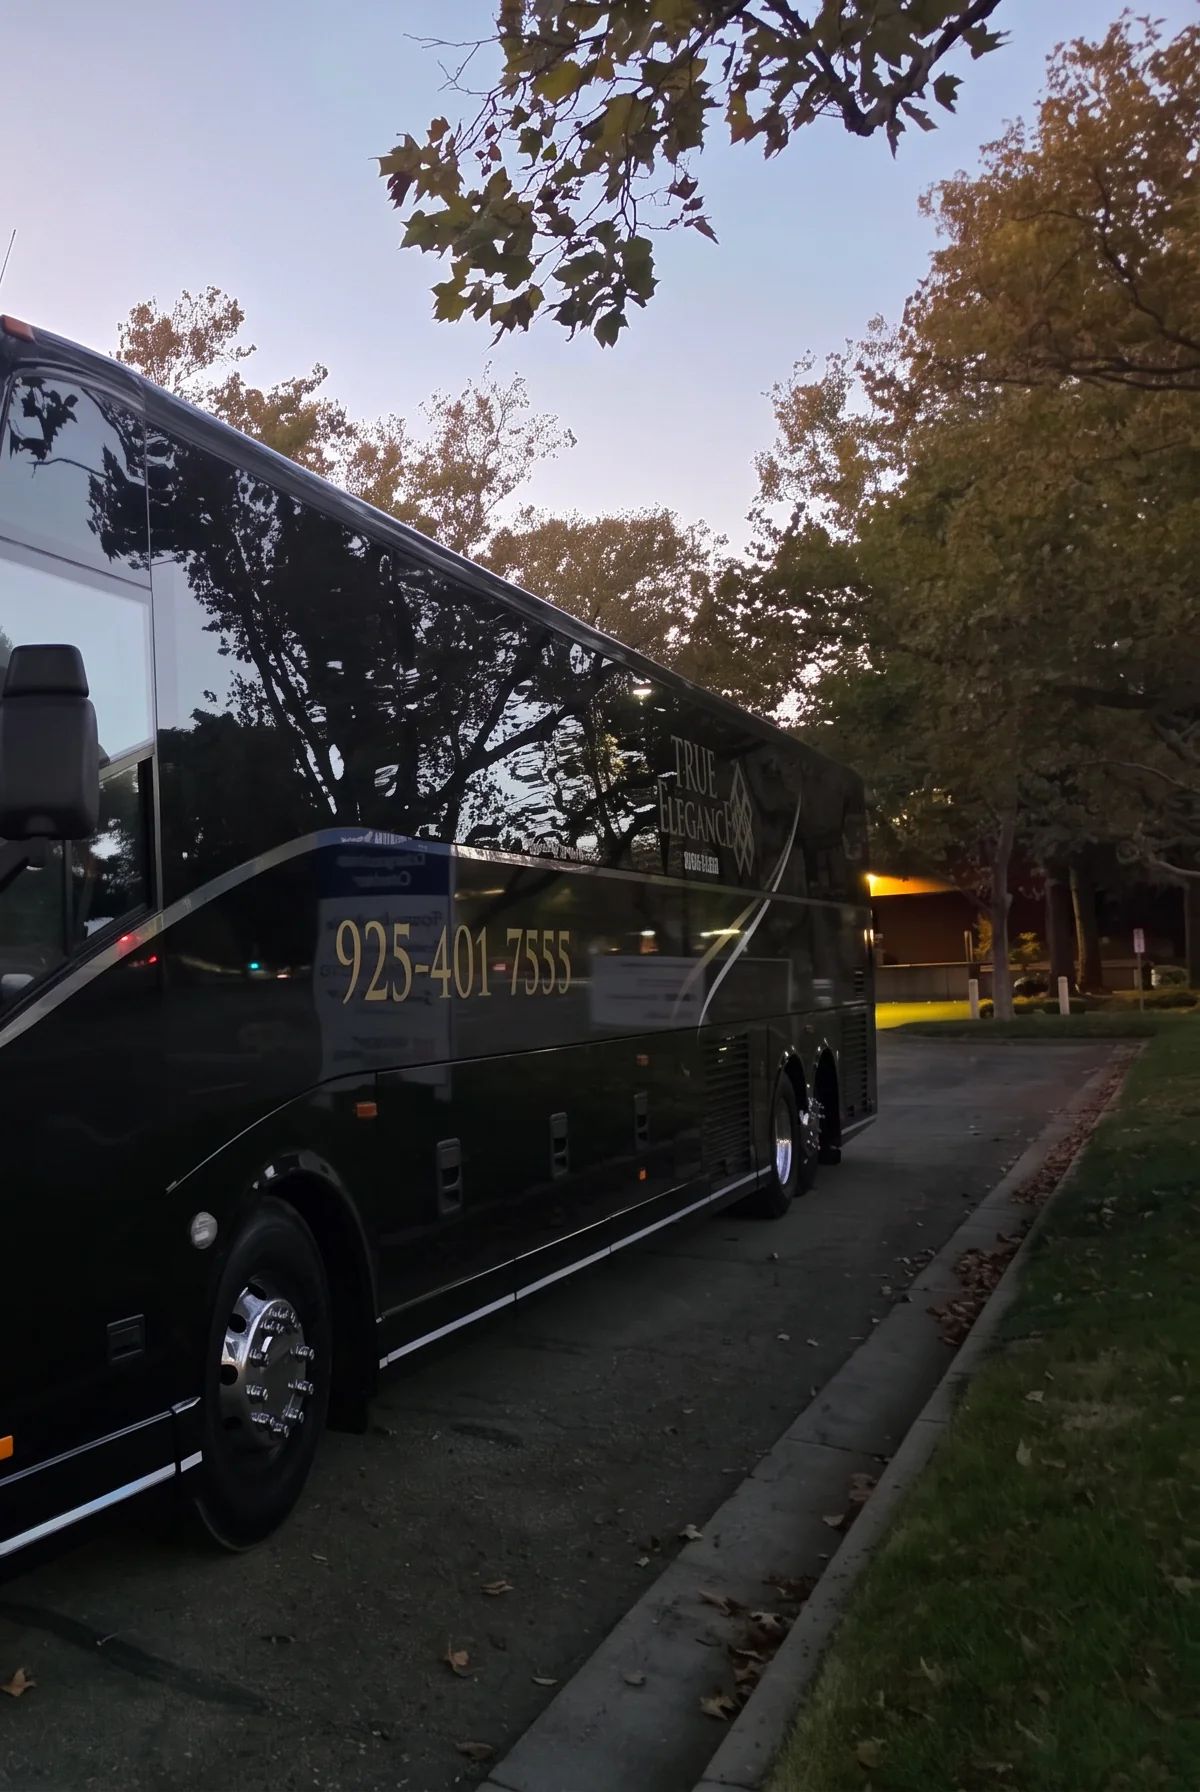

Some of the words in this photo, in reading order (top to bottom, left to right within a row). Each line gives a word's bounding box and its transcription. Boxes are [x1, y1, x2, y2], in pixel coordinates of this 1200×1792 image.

[670, 734, 718, 800] TRUE
[657, 778, 735, 849] ELEGANCE
[335, 919, 492, 1005] 925-401
[506, 927, 571, 996] 7555
